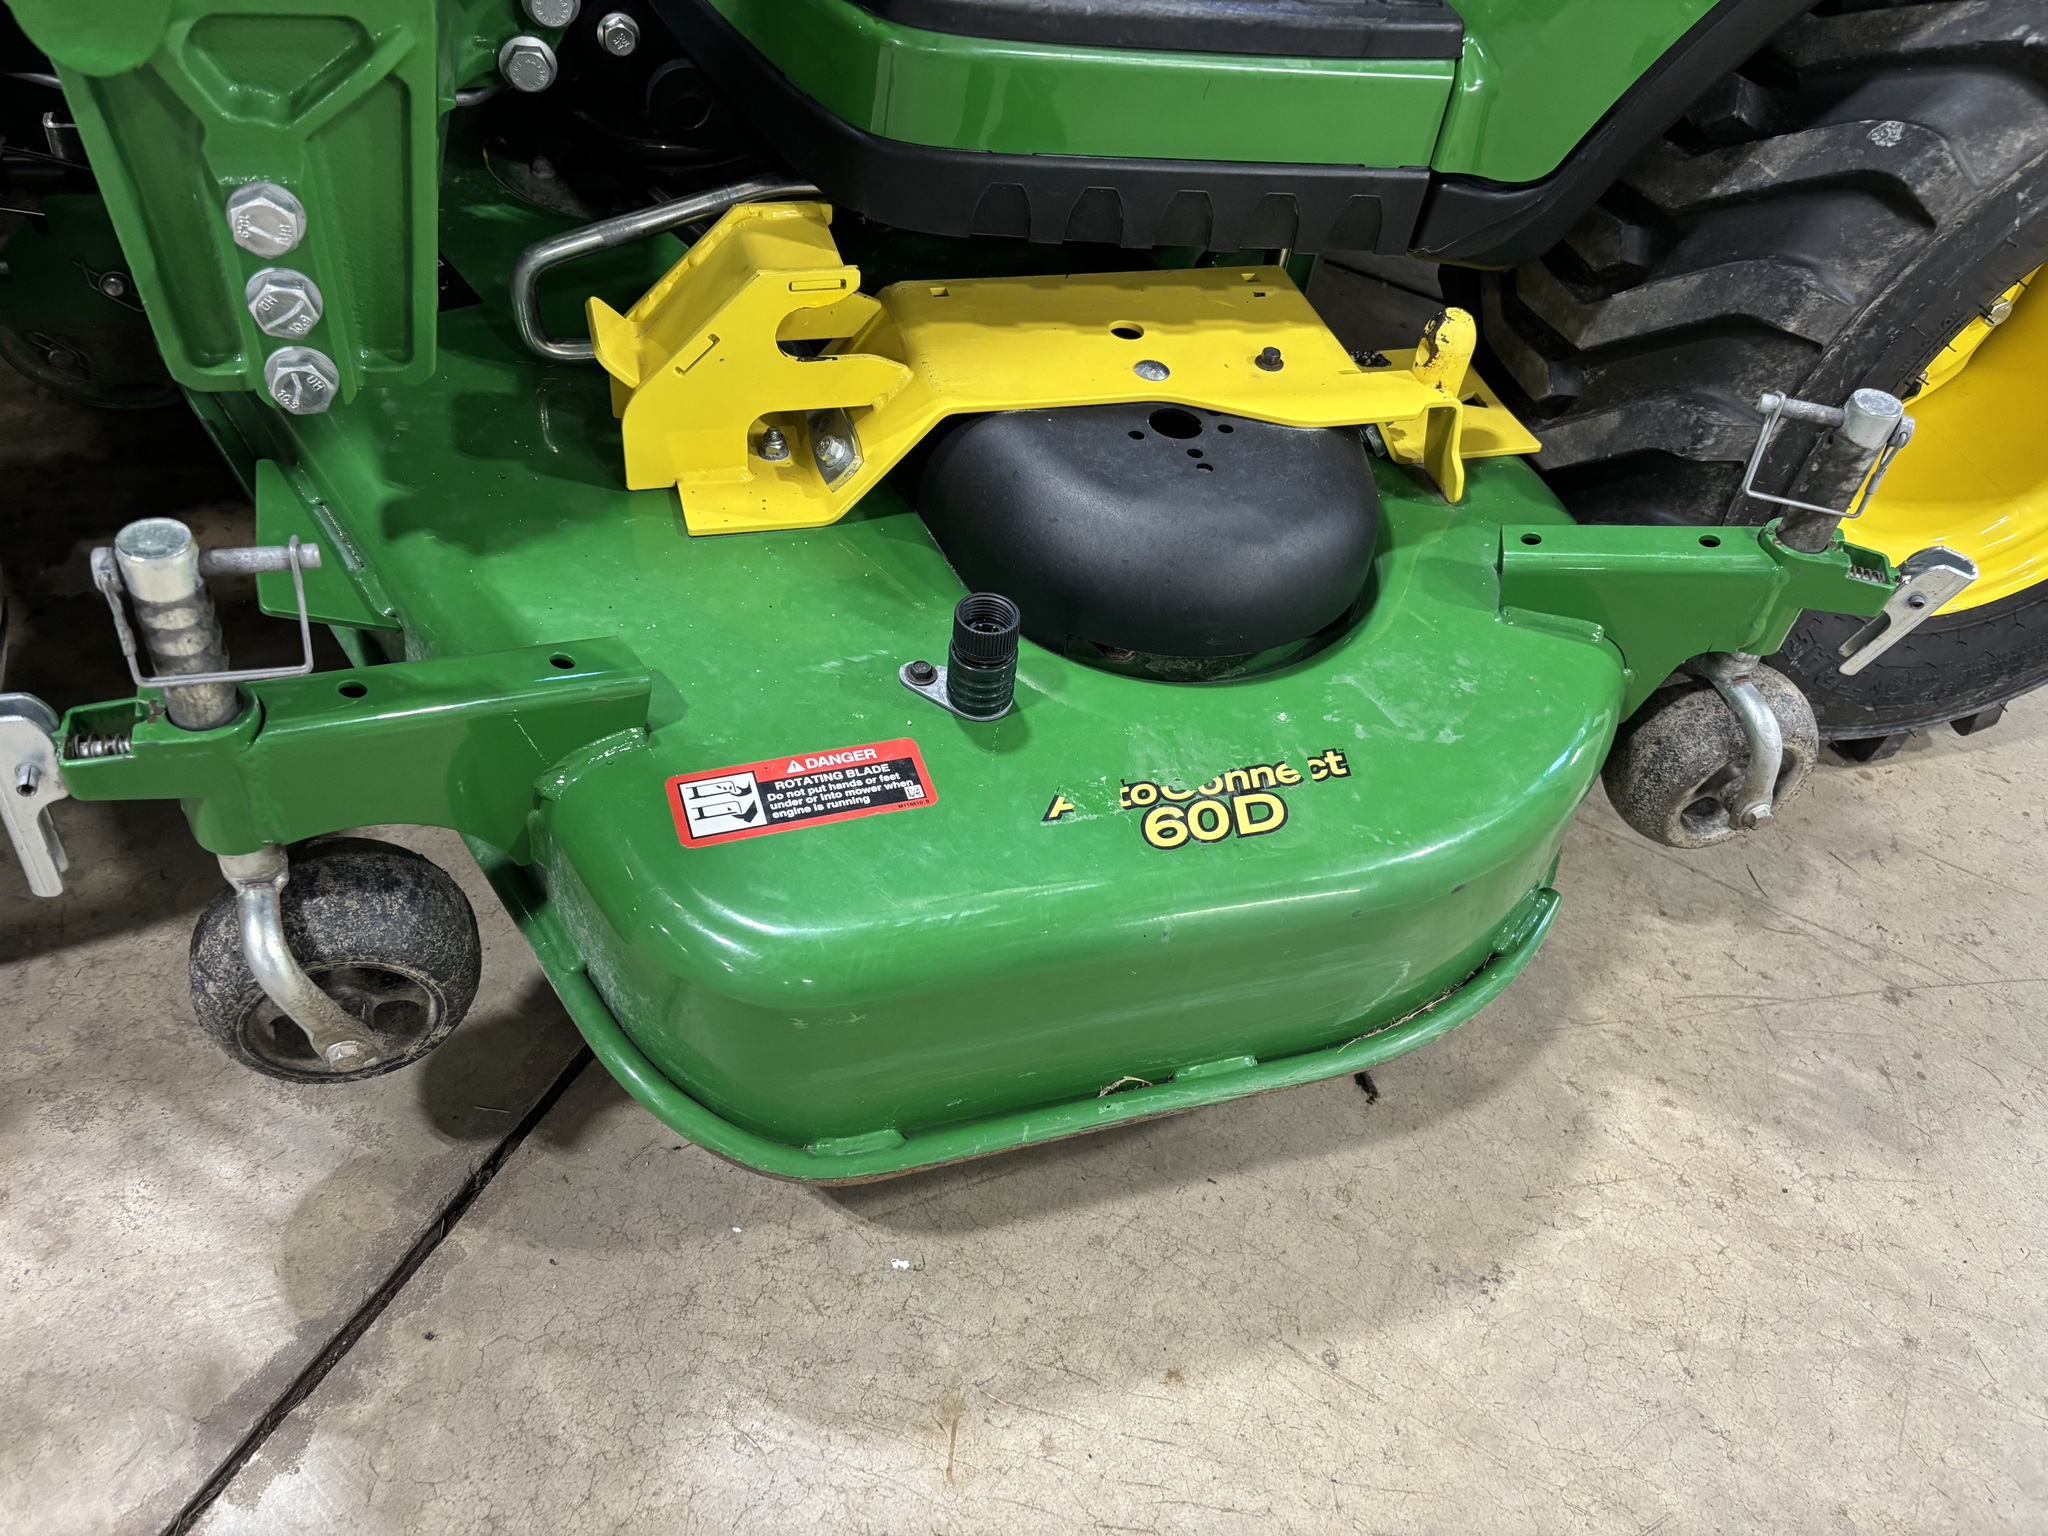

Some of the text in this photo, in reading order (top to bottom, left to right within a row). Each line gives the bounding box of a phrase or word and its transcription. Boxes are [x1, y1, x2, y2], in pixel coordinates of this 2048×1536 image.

[289, 314, 312, 334] 10.9
[307, 375, 325, 391] UH
[277, 390, 300, 409] 10.9
[804, 748, 878, 769] DANGER
[767, 772, 901, 802] Do not put hands or feet
[774, 763, 891, 791] ROTATING BLADE
[769, 779, 914, 811] under or into mower when
[772, 795, 871, 819] engine is running
[1141, 791, 1289, 850] 60D
